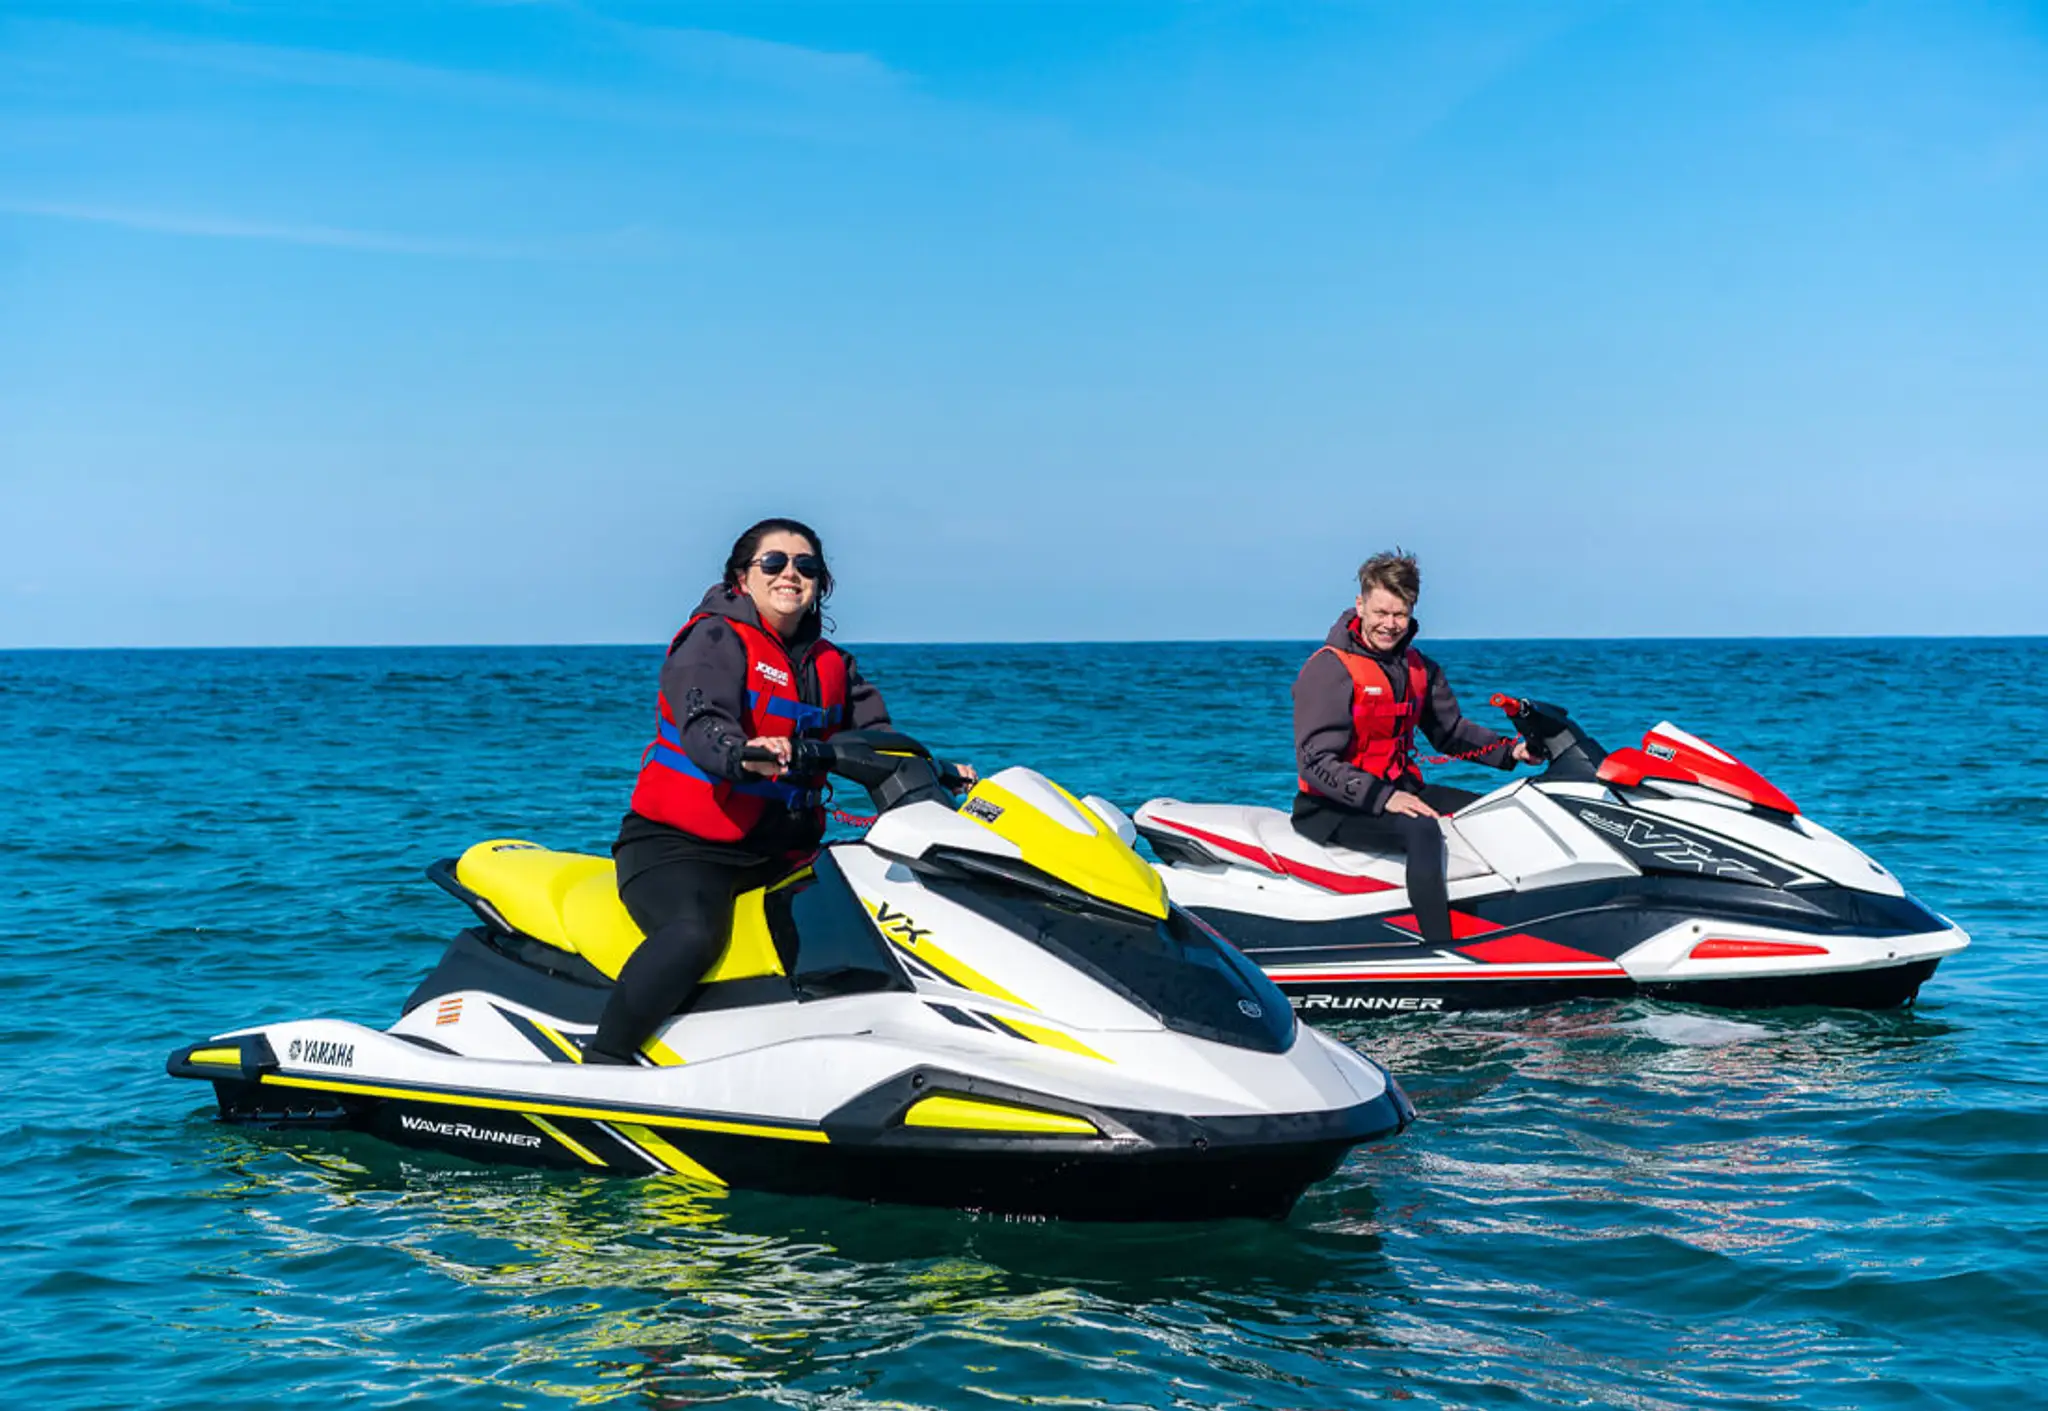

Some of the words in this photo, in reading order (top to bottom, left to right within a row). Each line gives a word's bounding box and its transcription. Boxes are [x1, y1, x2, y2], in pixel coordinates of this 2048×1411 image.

[877, 901, 932, 944] VX
[303, 1039, 355, 1067] YAMAHA
[401, 1116, 541, 1149] WAVERUNNER
